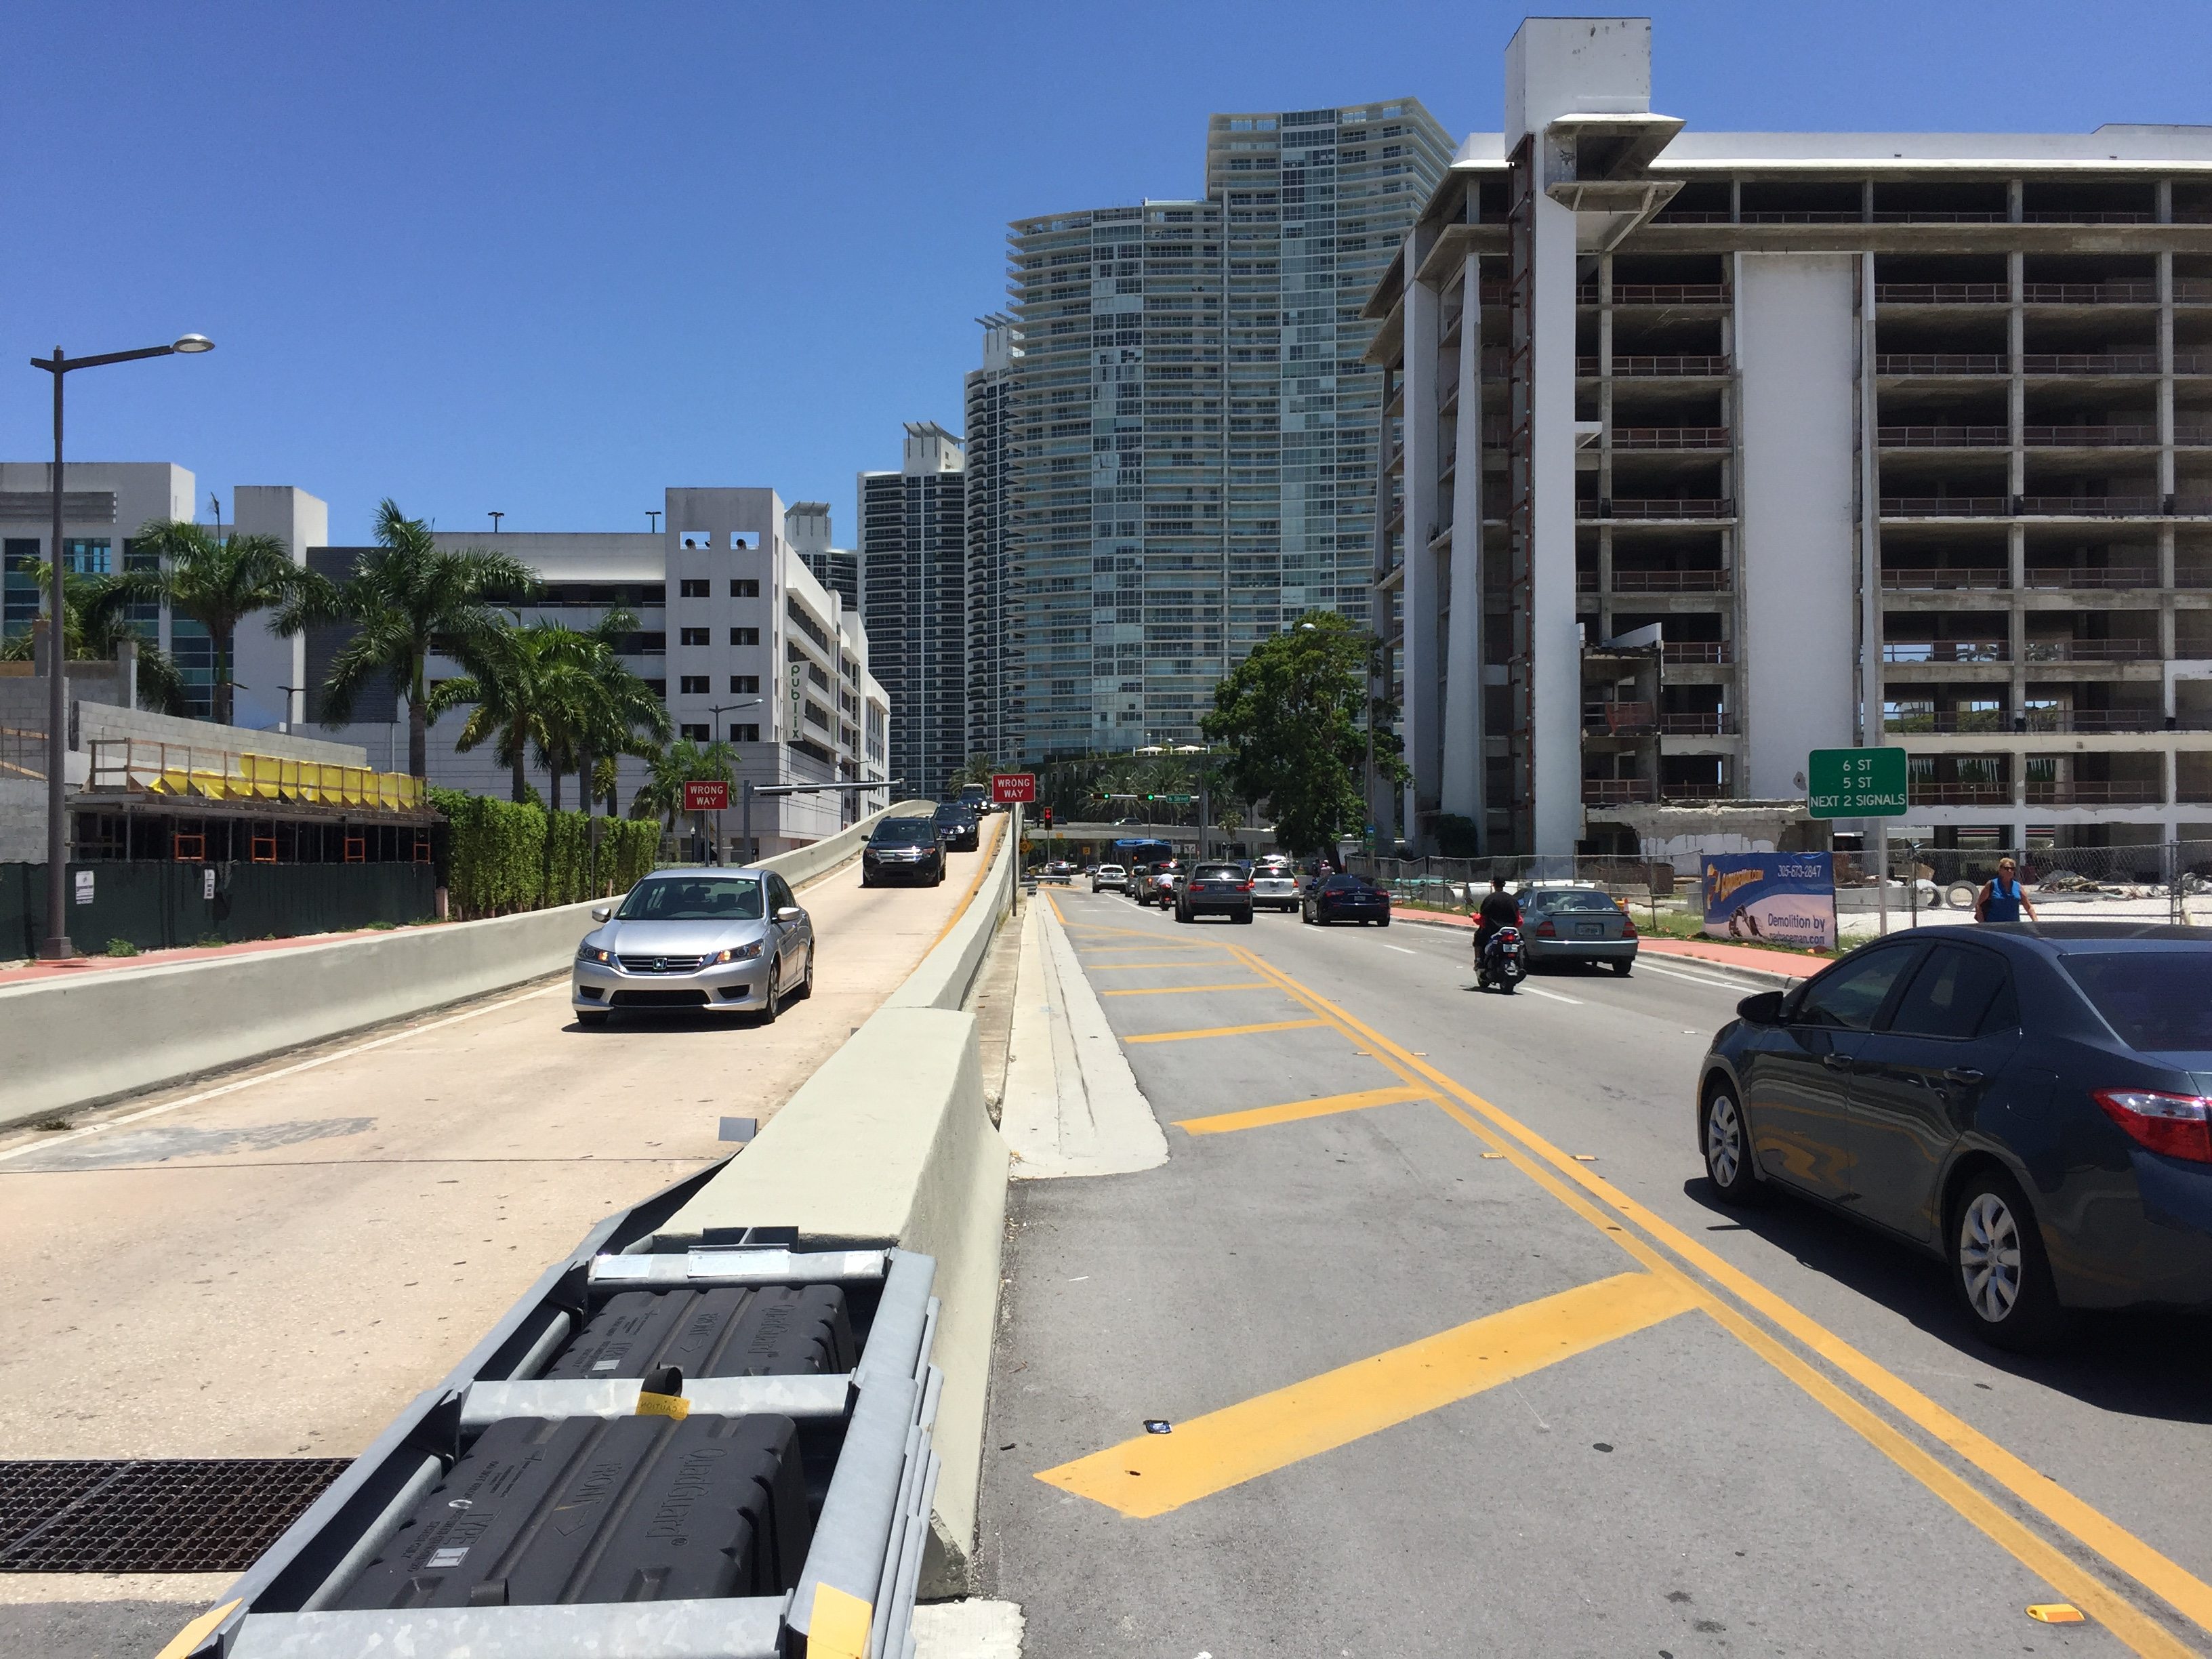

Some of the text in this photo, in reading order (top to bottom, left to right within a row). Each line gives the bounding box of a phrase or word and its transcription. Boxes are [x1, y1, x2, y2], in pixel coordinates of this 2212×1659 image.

[1843, 759, 1872, 771] 6 ST
[997, 778, 1030, 787] WRONG
[1843, 777, 1872, 789] 5 ST
[690, 785, 724, 795] WRONG
[1004, 789, 1024, 798] WAY
[696, 796, 717, 805] WAY
[1810, 793, 1906, 807] NEXT 2 SIGNALS
[1778, 864, 1822, 878] 305-673-2847
[1767, 913, 1825, 933] Demolition by
[572, 1462, 623, 1504] FRONT
[443, 1509, 501, 1544] TYPE
